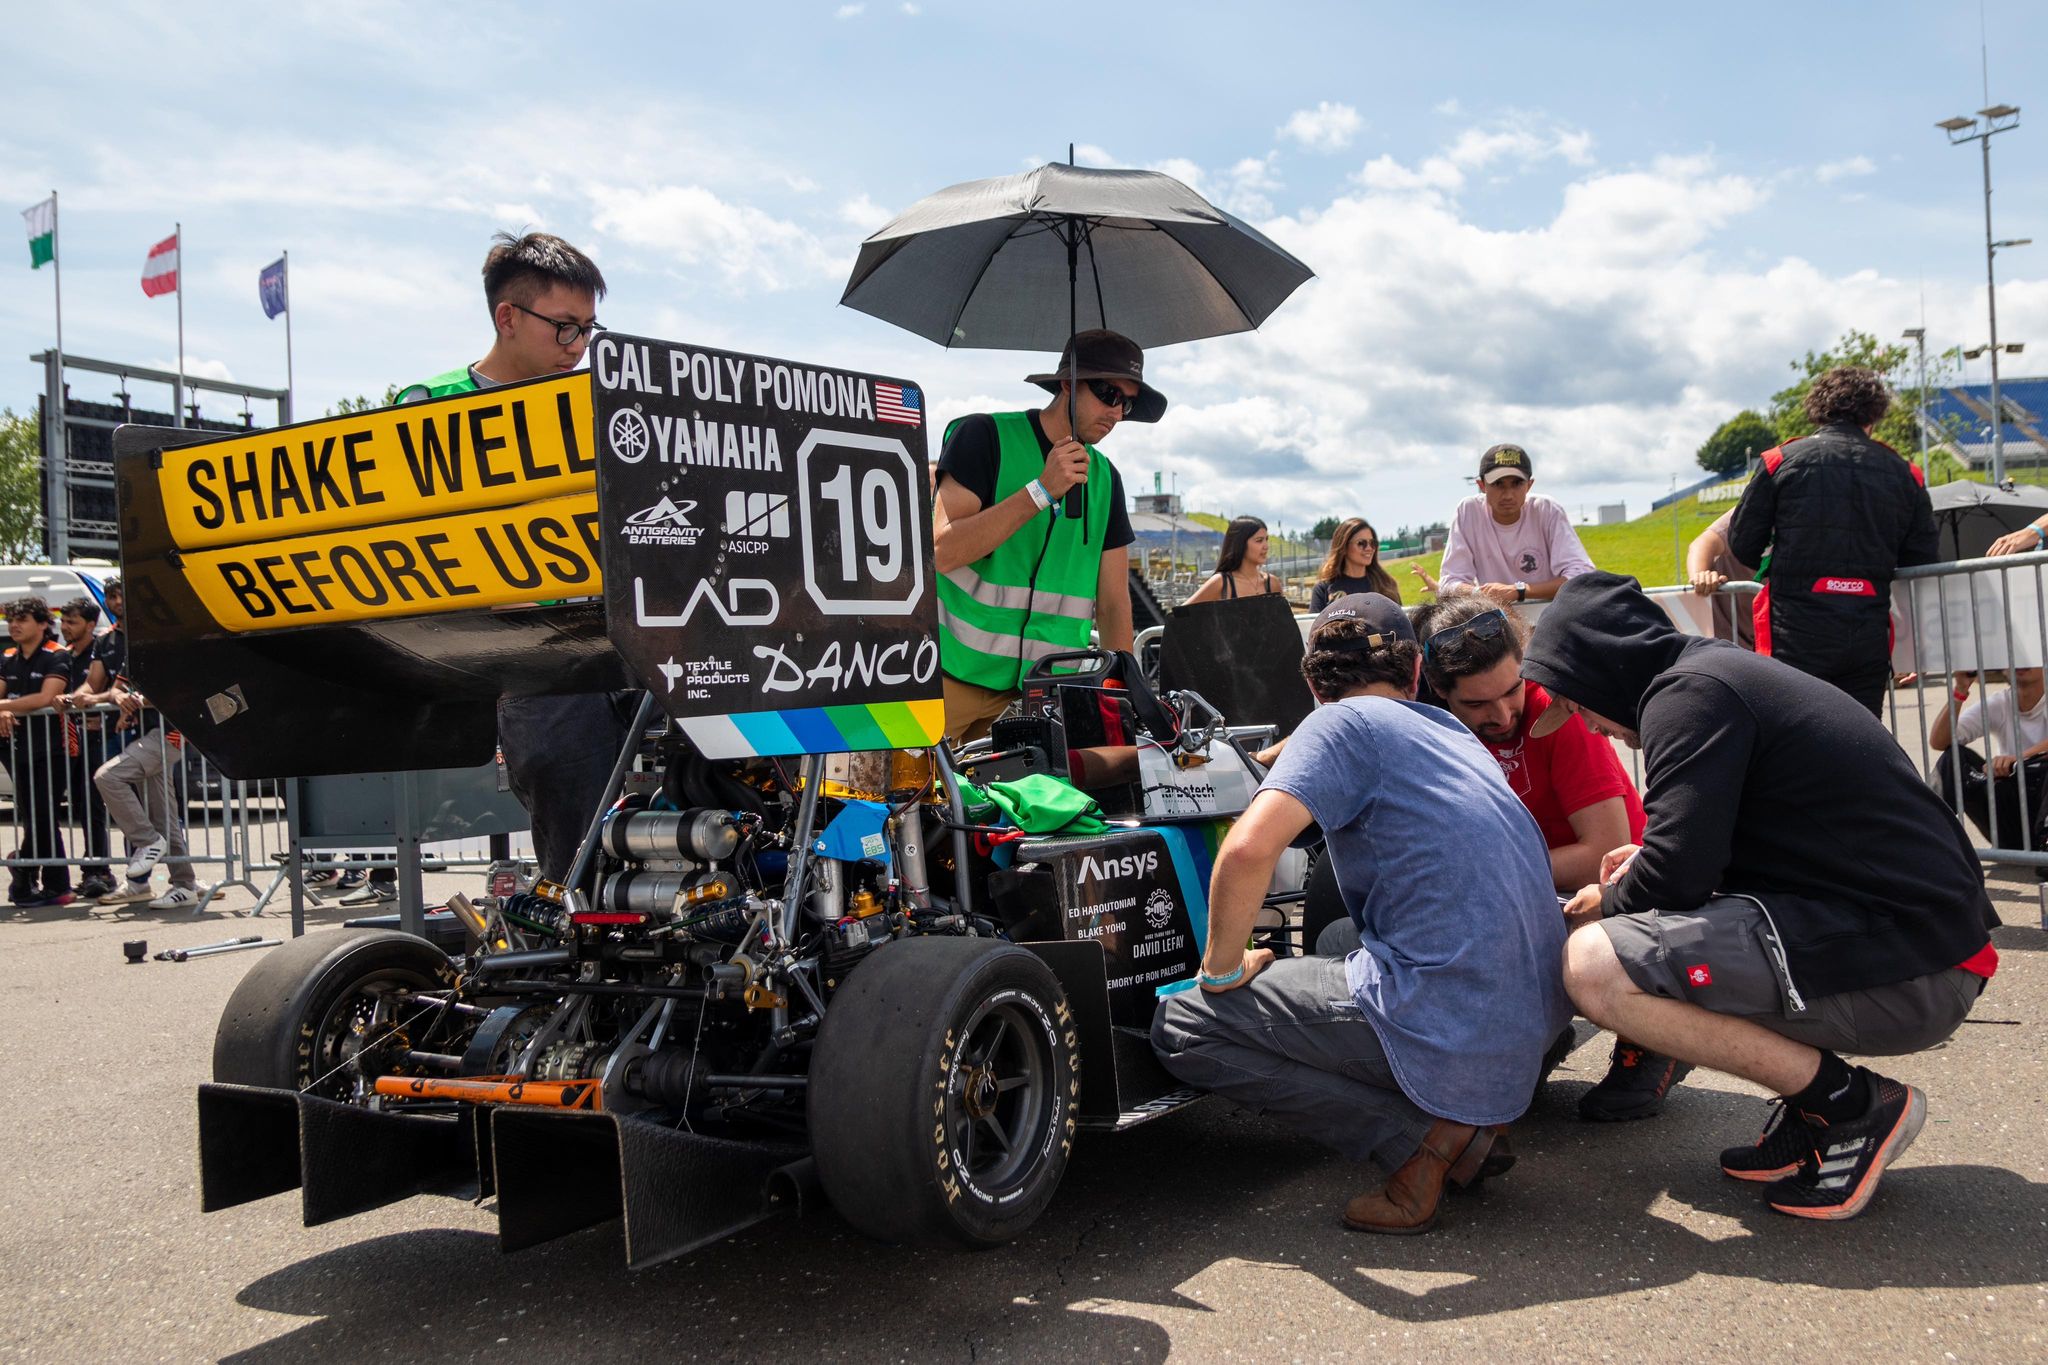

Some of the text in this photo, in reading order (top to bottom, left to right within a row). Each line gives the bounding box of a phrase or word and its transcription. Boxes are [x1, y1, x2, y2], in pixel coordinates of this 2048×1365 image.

[597, 339, 875, 422] CAL POLY POMONA
[651, 414, 783, 472] YAMAHA
[187, 391, 597, 530] SHAKE WELL
[620, 526, 705, 537] ANTIGRAVITY
[820, 464, 903, 583] 19
[629, 536, 697, 546] BATTERIES
[728, 540, 769, 554] ASICPP
[217, 532, 482, 619] BEFORE
[1826, 579, 1864, 592] sparco
[1328, 610, 1356, 618] MATLAB
[686, 661, 732, 671] TEXTILE
[752, 640, 938, 693] DANCO
[687, 674, 750, 685] PRODUCTS
[687, 689, 711, 699] INC.
[1077, 850, 1159, 884] Ansys
[1068, 897, 1137, 918] ED HAROUTONIAN
[1078, 921, 1127, 939] BLAKE YOHO
[1133, 934, 1185, 958] DAVID LEFAY
[1107, 976, 1134, 990] EMORY
[1135, 974, 1144, 984] OF
[1145, 970, 1159, 981] RON
